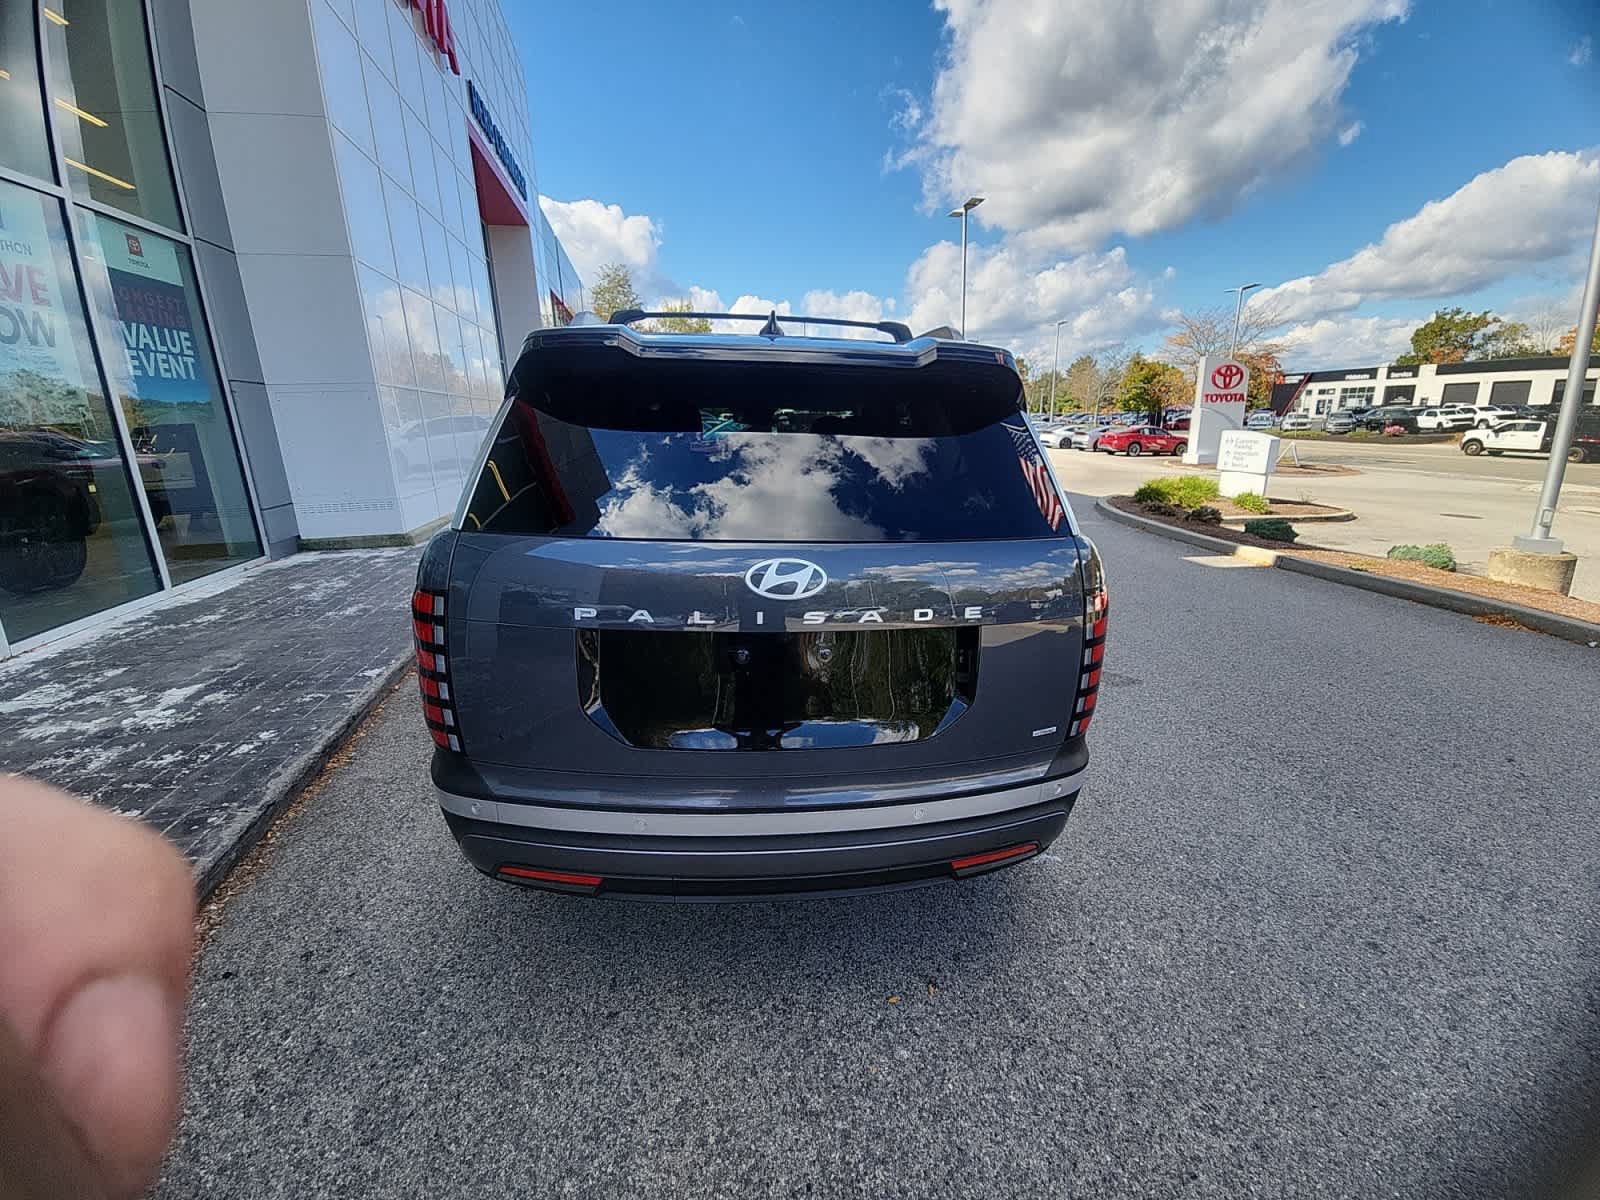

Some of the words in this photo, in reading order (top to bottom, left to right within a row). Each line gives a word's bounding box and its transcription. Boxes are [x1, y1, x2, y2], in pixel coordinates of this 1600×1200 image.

[0, 261, 52, 307] VE
[121, 320, 195, 357] VALUE
[127, 349, 196, 381] EVENT
[1204, 392, 1245, 403] TOYOTA
[573, 605, 984, 627] PALISADE
